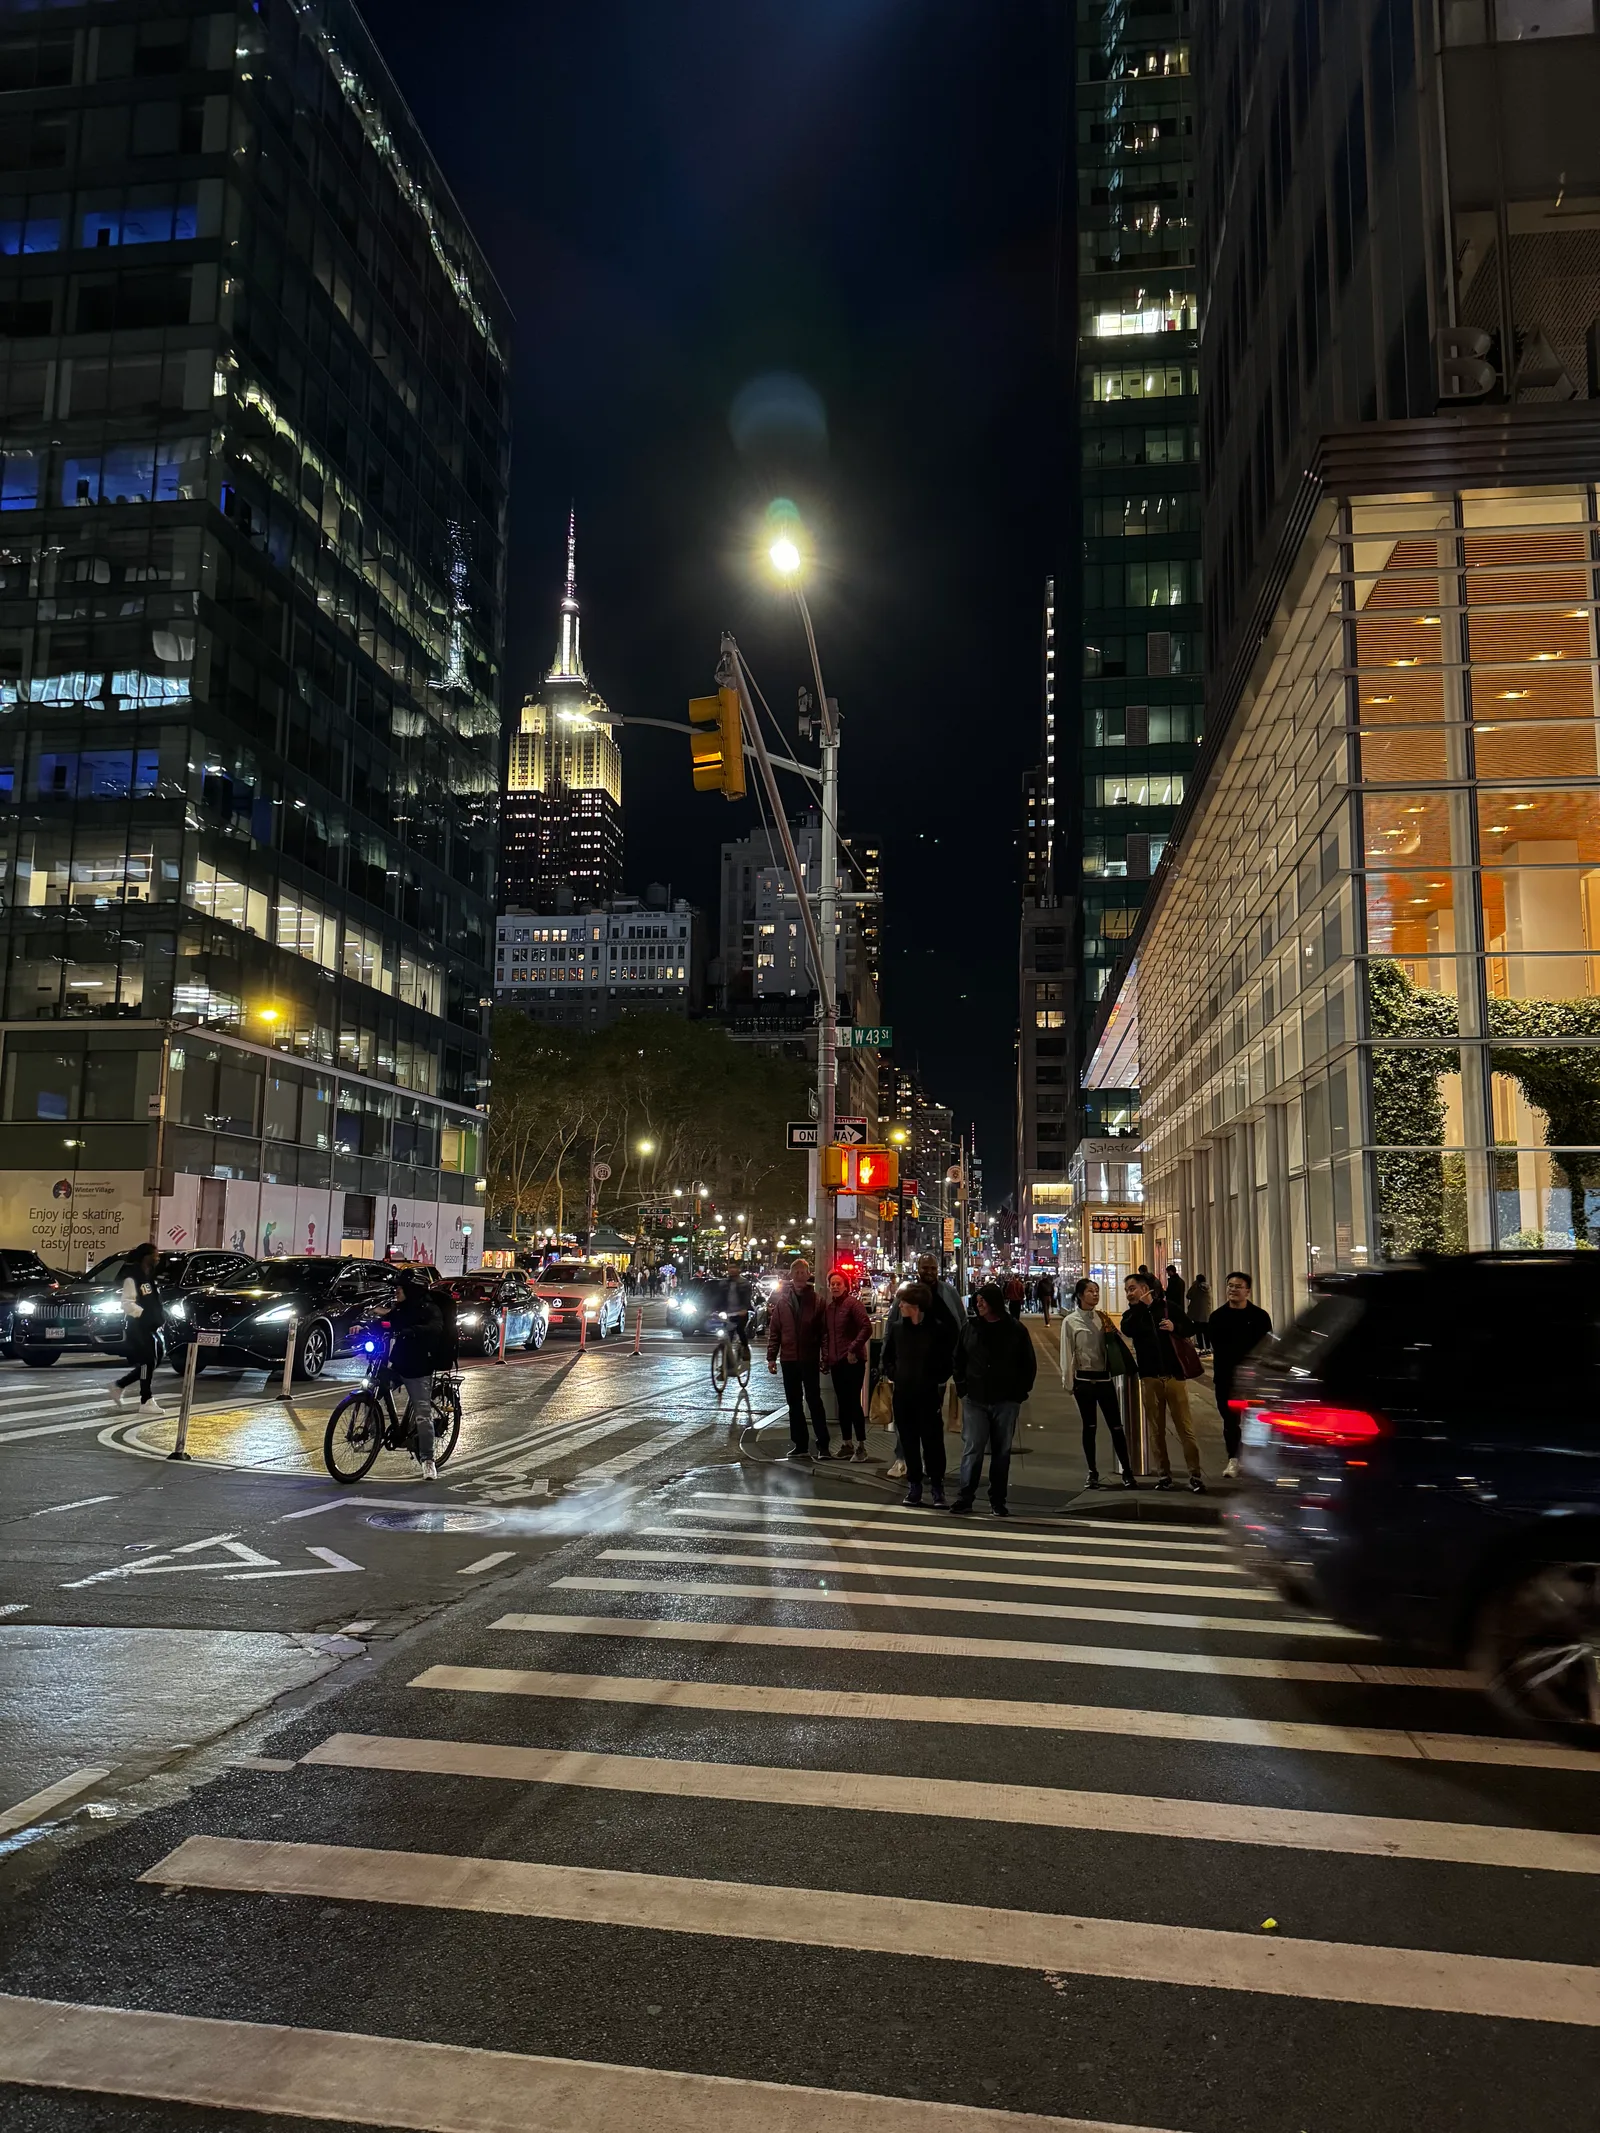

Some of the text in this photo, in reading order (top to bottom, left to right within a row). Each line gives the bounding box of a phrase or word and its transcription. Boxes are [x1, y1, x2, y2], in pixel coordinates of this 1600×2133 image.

[1436, 318, 1600, 404] BA
[855, 1029, 889, 1044] W 43 St
[1089, 1143, 1135, 1153] Salesfo
[95, 1186, 115, 1194] Village
[29, 1207, 125, 1223] Enjoy ice skating,
[32, 1222, 120, 1237] cozy igloos, and
[41, 1239, 106, 1251] tasty treats
